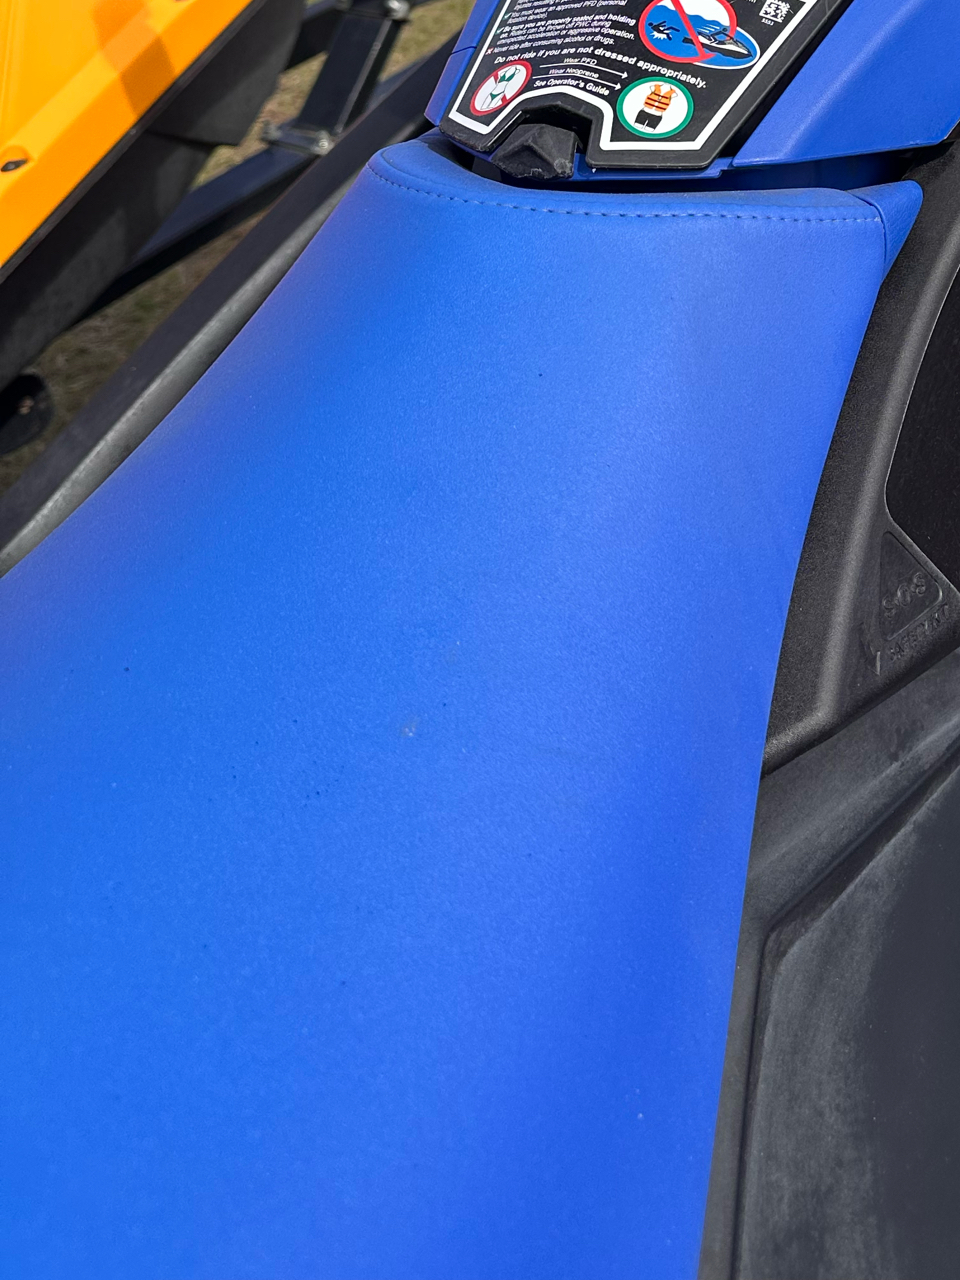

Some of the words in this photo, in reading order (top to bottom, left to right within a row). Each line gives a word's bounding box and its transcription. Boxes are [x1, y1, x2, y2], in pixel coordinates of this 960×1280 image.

[506, 53, 519, 61] not
[520, 51, 535, 59] ride
[537, 49, 543, 57] if
[542, 49, 559, 57] you
[594, 47, 636, 65] dressed
[637, 61, 706, 88] appropriately.
[547, 77, 584, 88] Operator's
[586, 81, 609, 96] Guide
